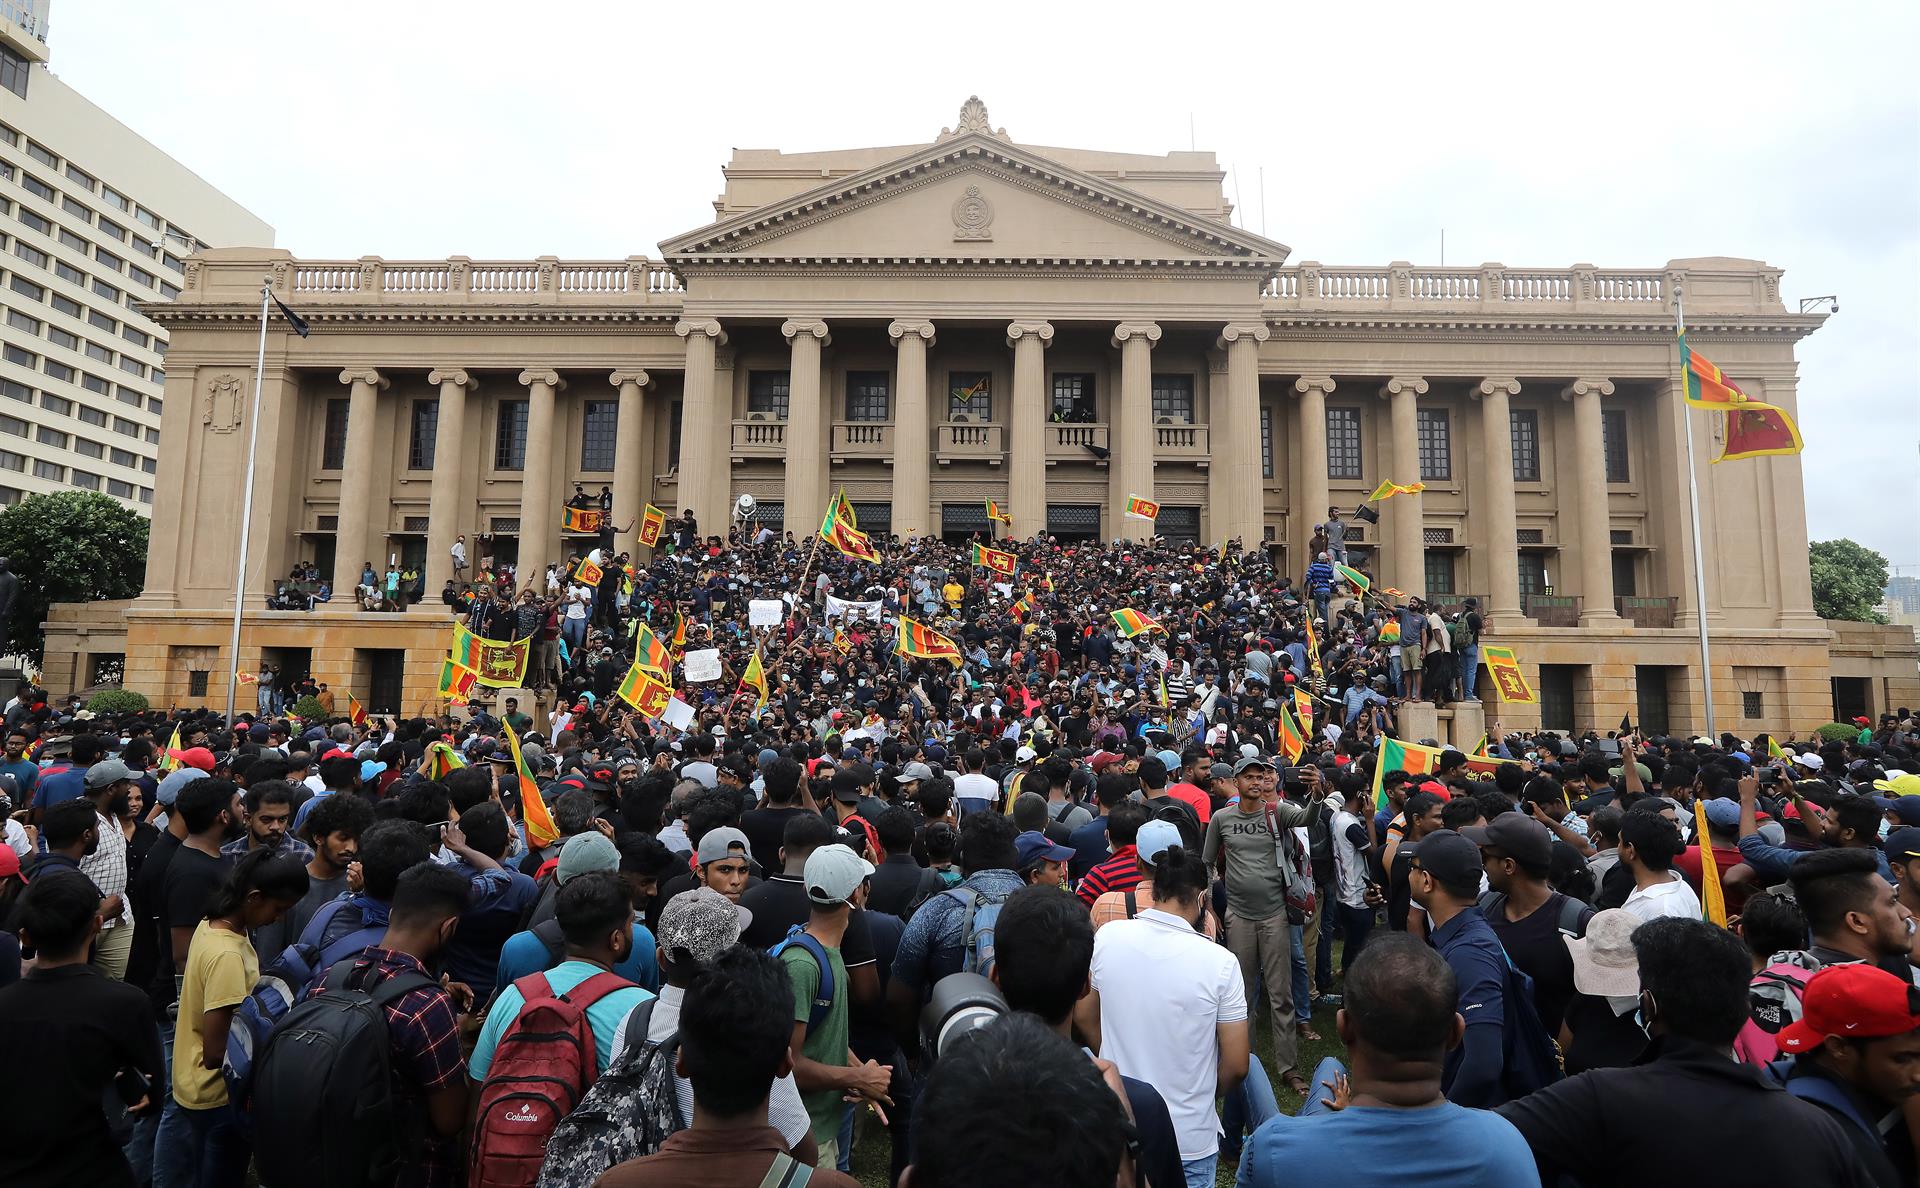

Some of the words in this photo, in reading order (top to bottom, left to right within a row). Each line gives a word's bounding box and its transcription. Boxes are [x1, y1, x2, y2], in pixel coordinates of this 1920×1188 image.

[1232, 821, 1270, 835] BOS
[1755, 1005, 1780, 1018] NORTH
[1767, 1004, 1780, 1012] THE
[1760, 1011, 1779, 1023] FACE
[505, 1111, 538, 1122] Columbia
